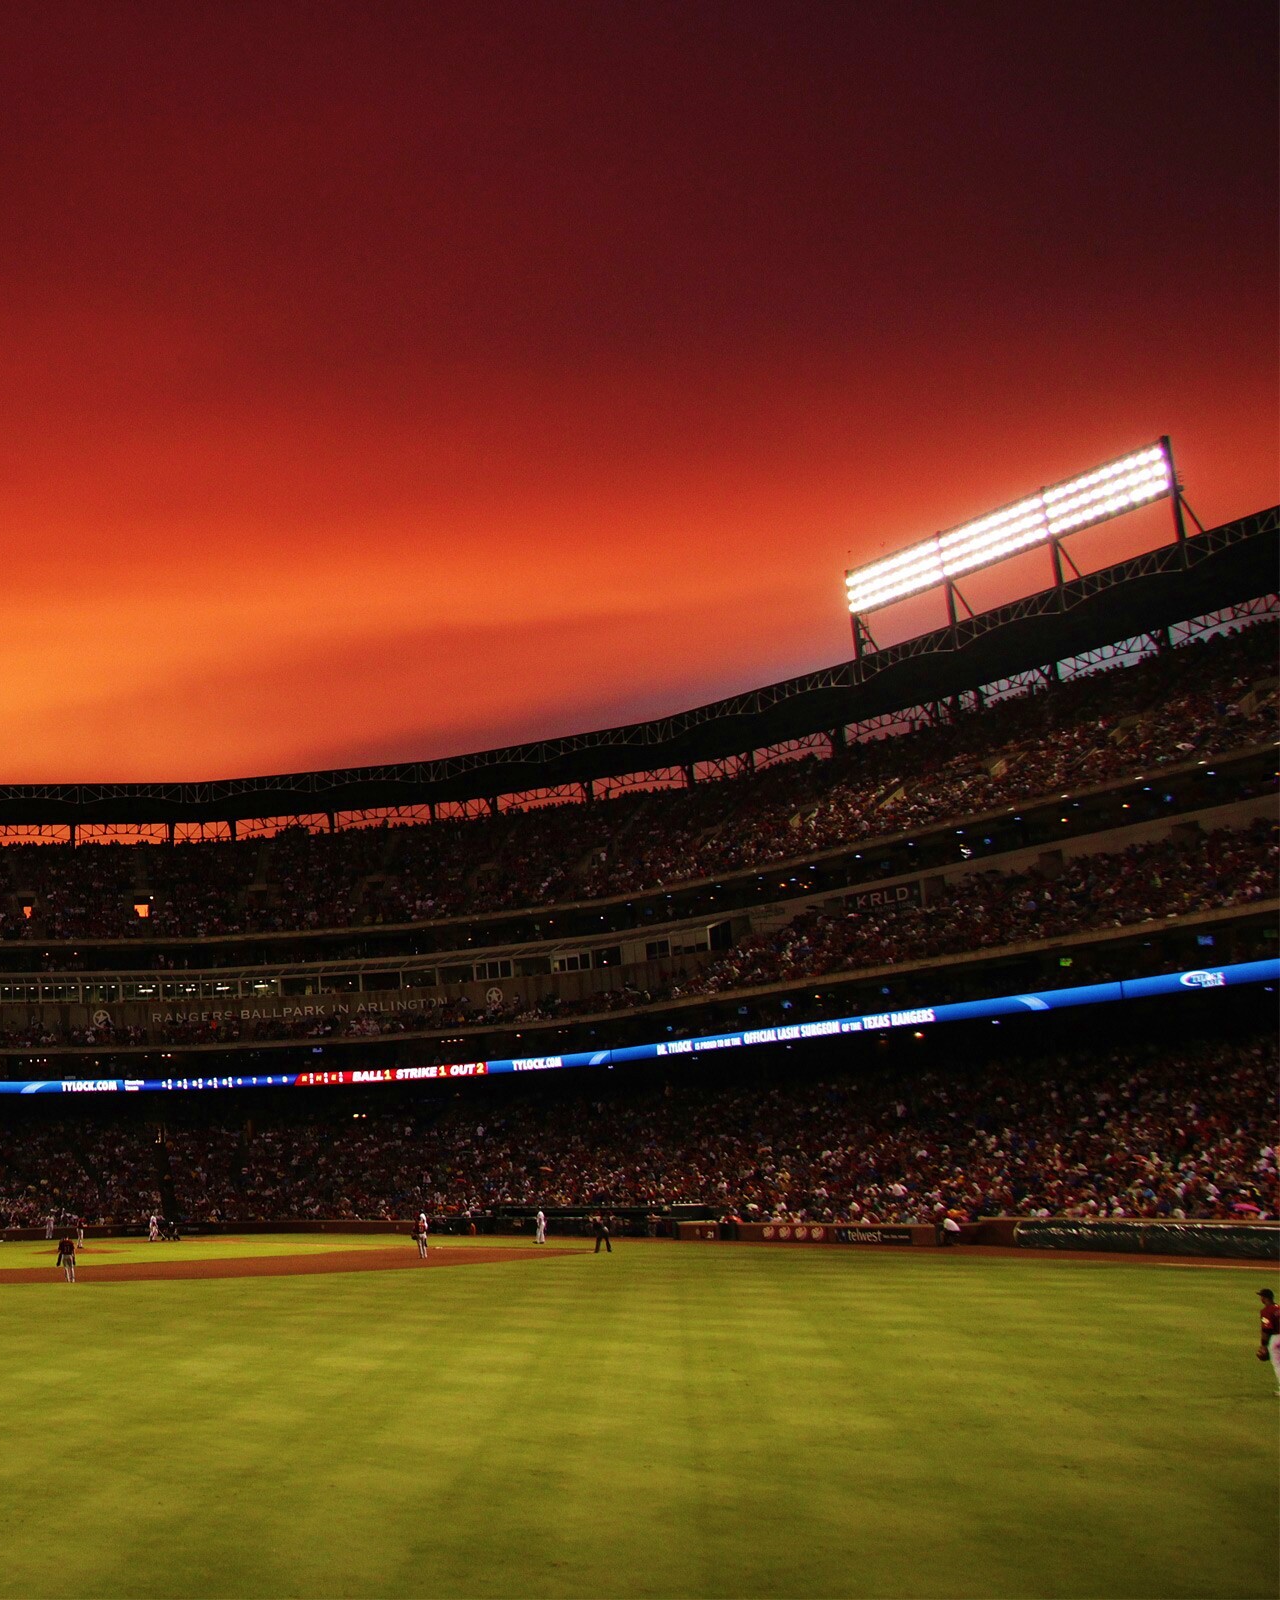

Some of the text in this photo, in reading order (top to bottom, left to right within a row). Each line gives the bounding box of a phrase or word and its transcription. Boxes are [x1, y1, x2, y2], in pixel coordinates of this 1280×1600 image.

[856, 887, 908, 909] KRLD
[152, 997, 448, 1023] RANGERS BALLPARK IN ARLINGTON
[657, 1044, 667, 1055] DR.
[668, 1041, 692, 1053] TYLOCK
[744, 1030, 776, 1044] OFFICIAL
[777, 1026, 800, 1040] LASIK
[801, 1021, 840, 1037] SURGEON
[863, 1015, 890, 1029] TEXAS
[891, 1009, 934, 1025] RANGERS
[352, 1063, 485, 1081] BALL 1 STRIKE 1 OUT 2
[512, 1057, 561, 1070] TYLOCK.COM
[62, 1081, 117, 1091] TYLOCK.COM
[847, 1228, 882, 1243] telwest
